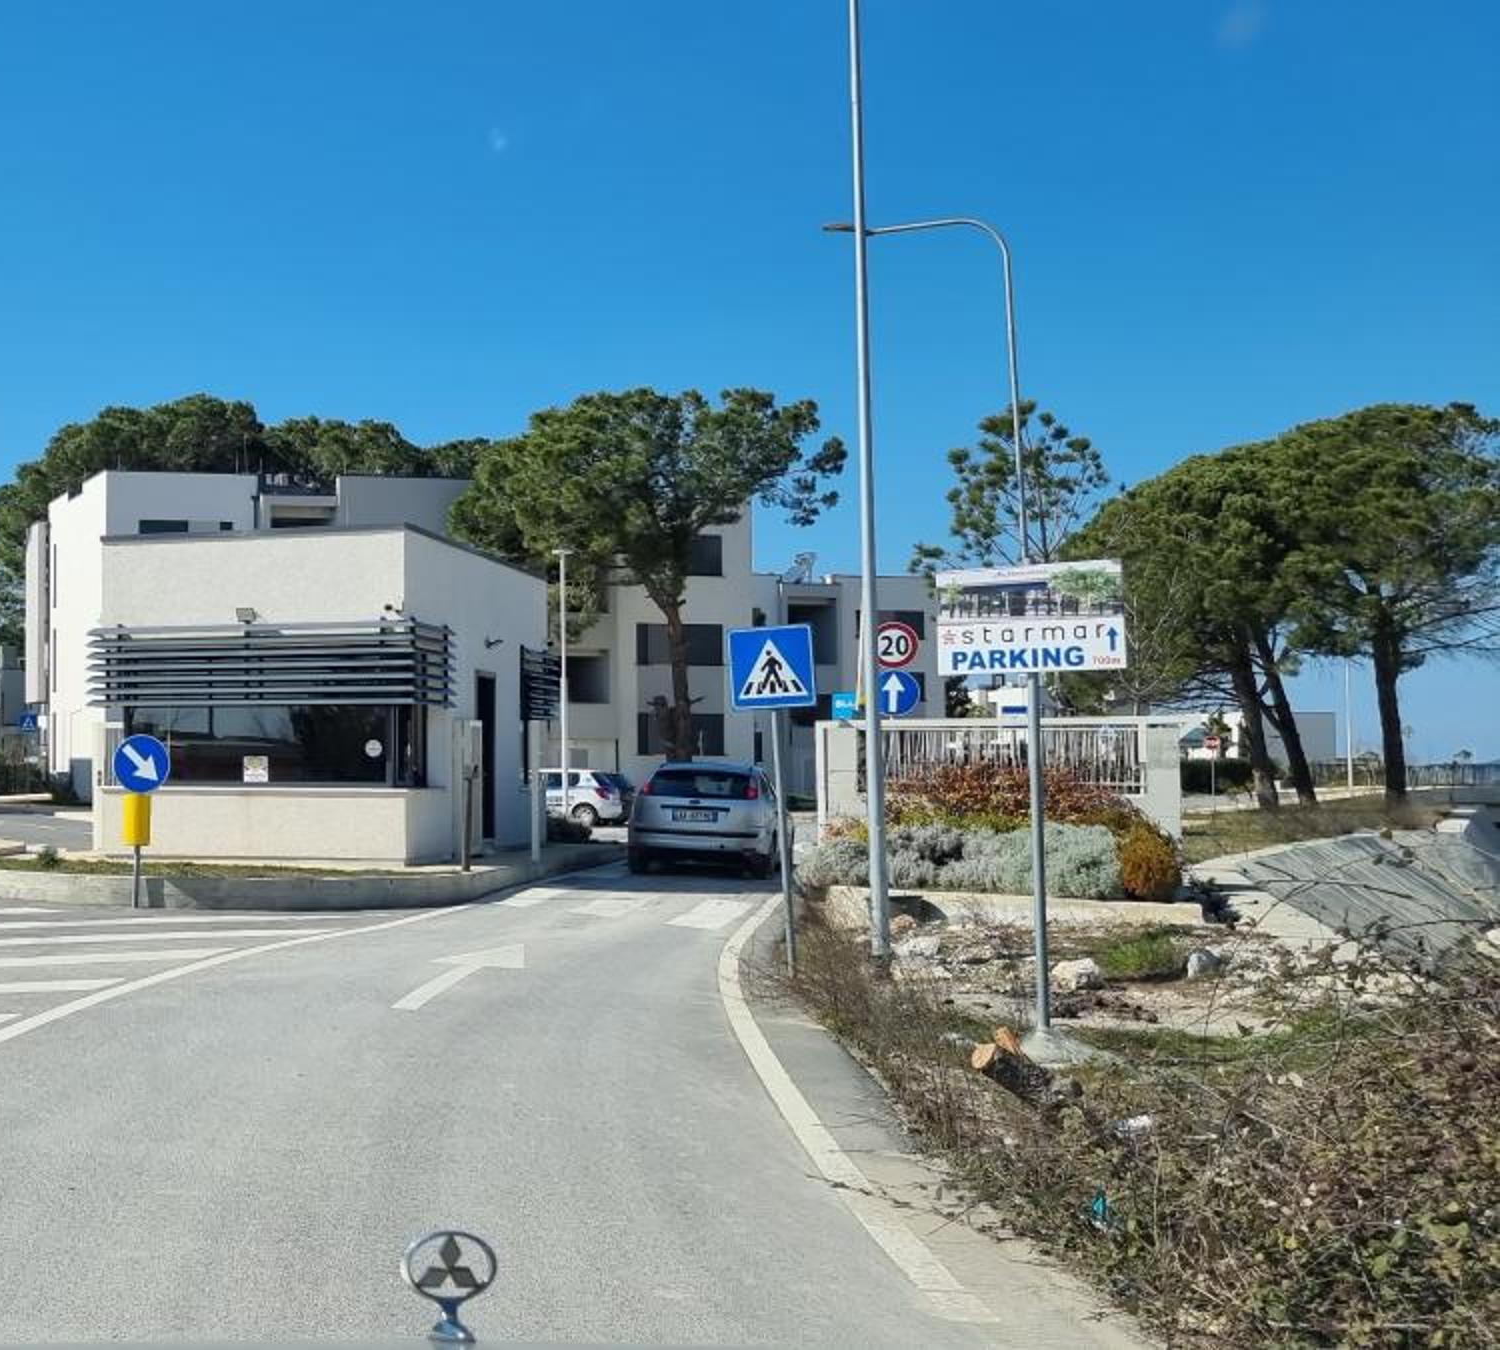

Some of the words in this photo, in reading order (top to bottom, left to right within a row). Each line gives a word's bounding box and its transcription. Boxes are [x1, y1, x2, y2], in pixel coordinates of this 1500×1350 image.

[962, 624, 1106, 644] starmar
[881, 635, 909, 656] 20
[952, 646, 1085, 670] PARKING
